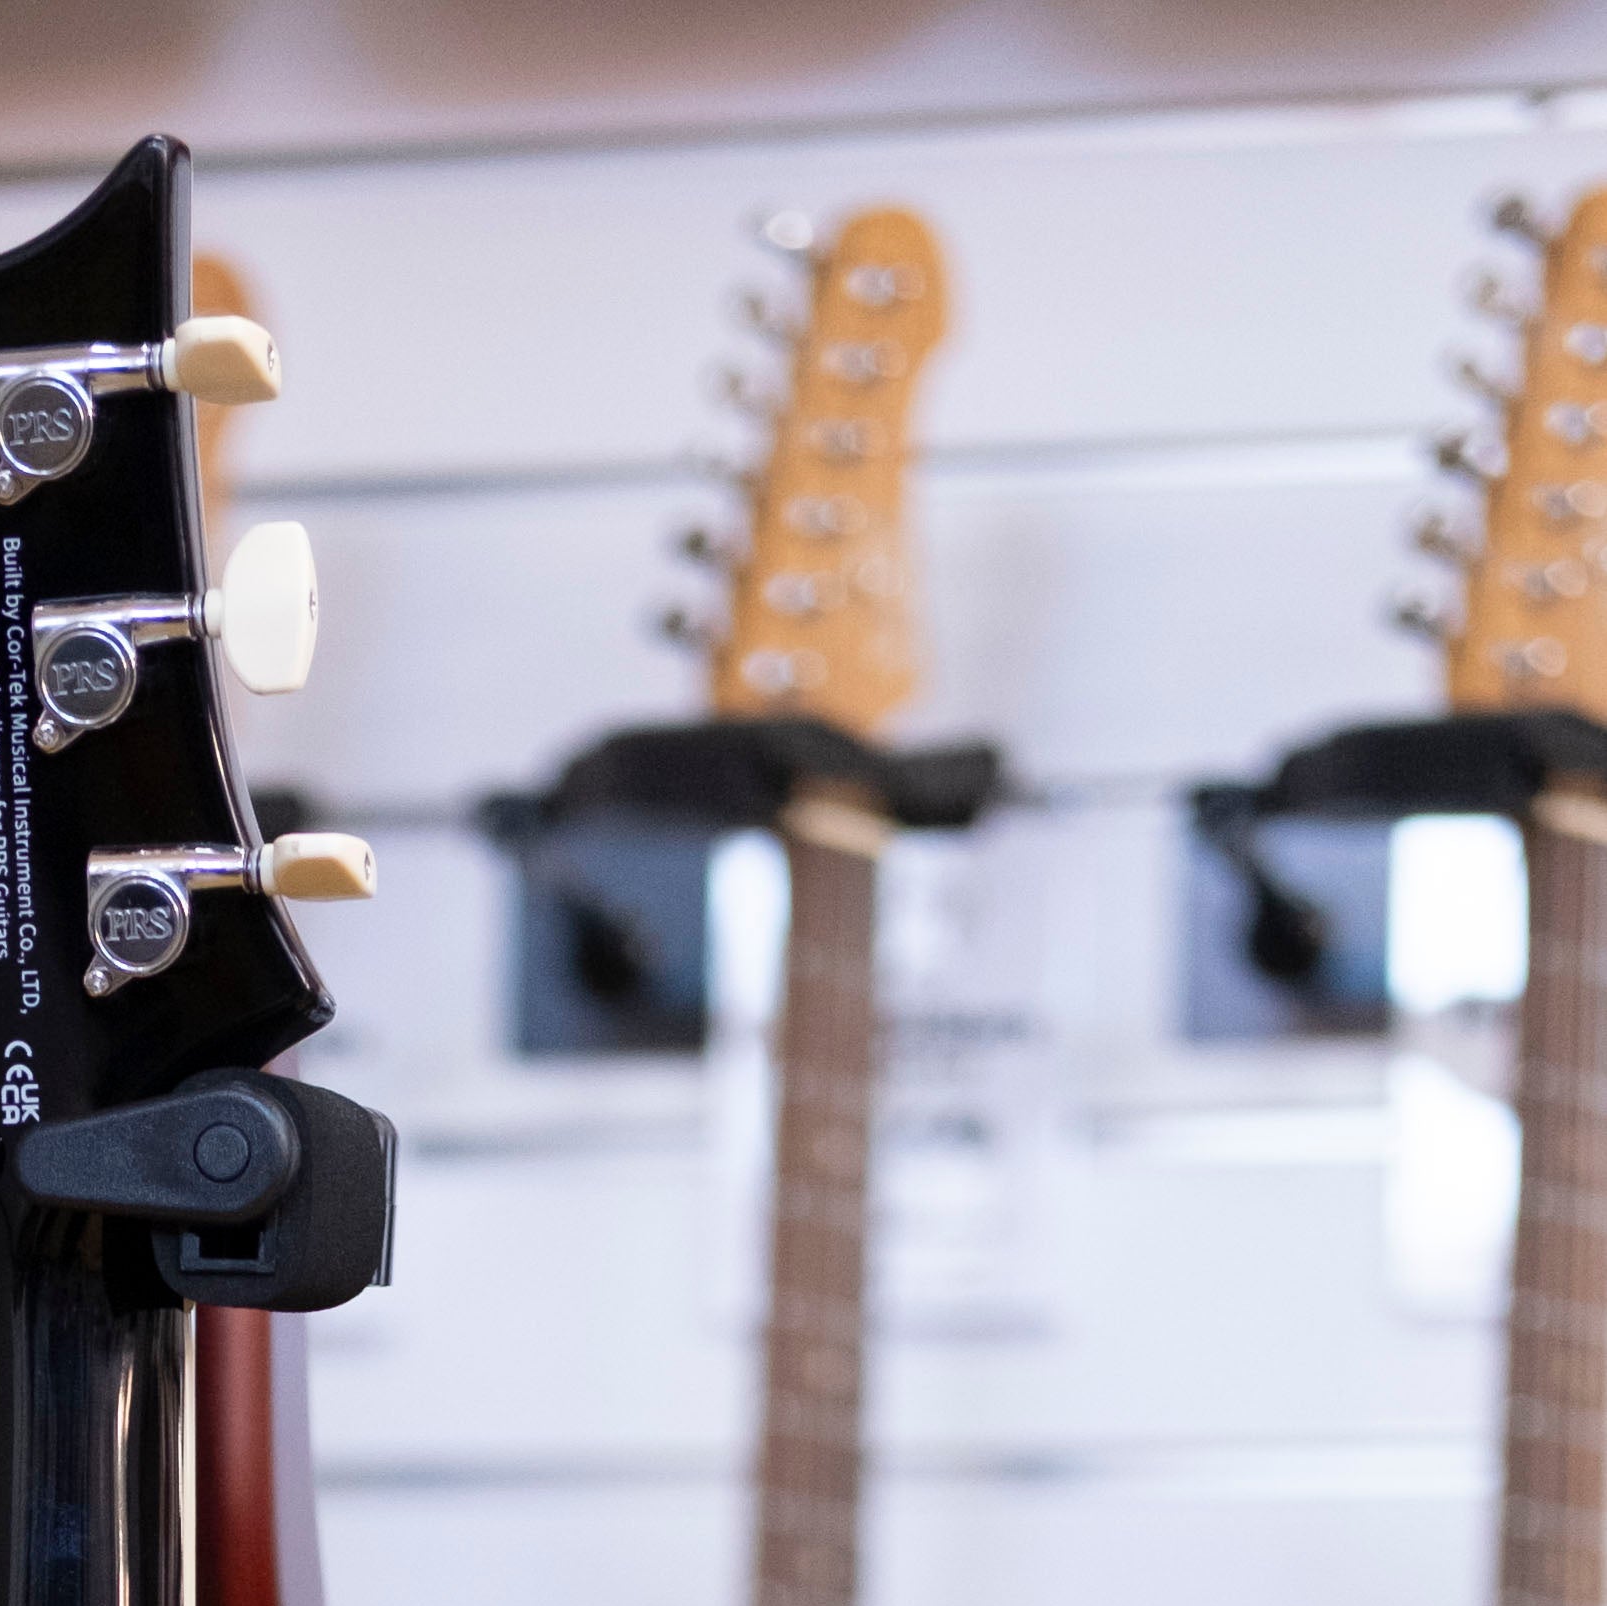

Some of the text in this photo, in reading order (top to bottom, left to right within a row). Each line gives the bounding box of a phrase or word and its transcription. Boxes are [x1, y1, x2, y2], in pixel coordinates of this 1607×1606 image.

[8, 408, 75, 446] PRS
[3, 538, 23, 588] Built
[2, 595, 24, 619] by
[7, 626, 29, 707] Cor-Tek
[53, 658, 117, 697] PRS
[11, 714, 31, 793] Musical
[14, 799, 35, 917] Instrument
[106, 907, 172, 942] PRS
[1, 1084, 20, 1124] CA
[21, 1084, 40, 1122] UK
